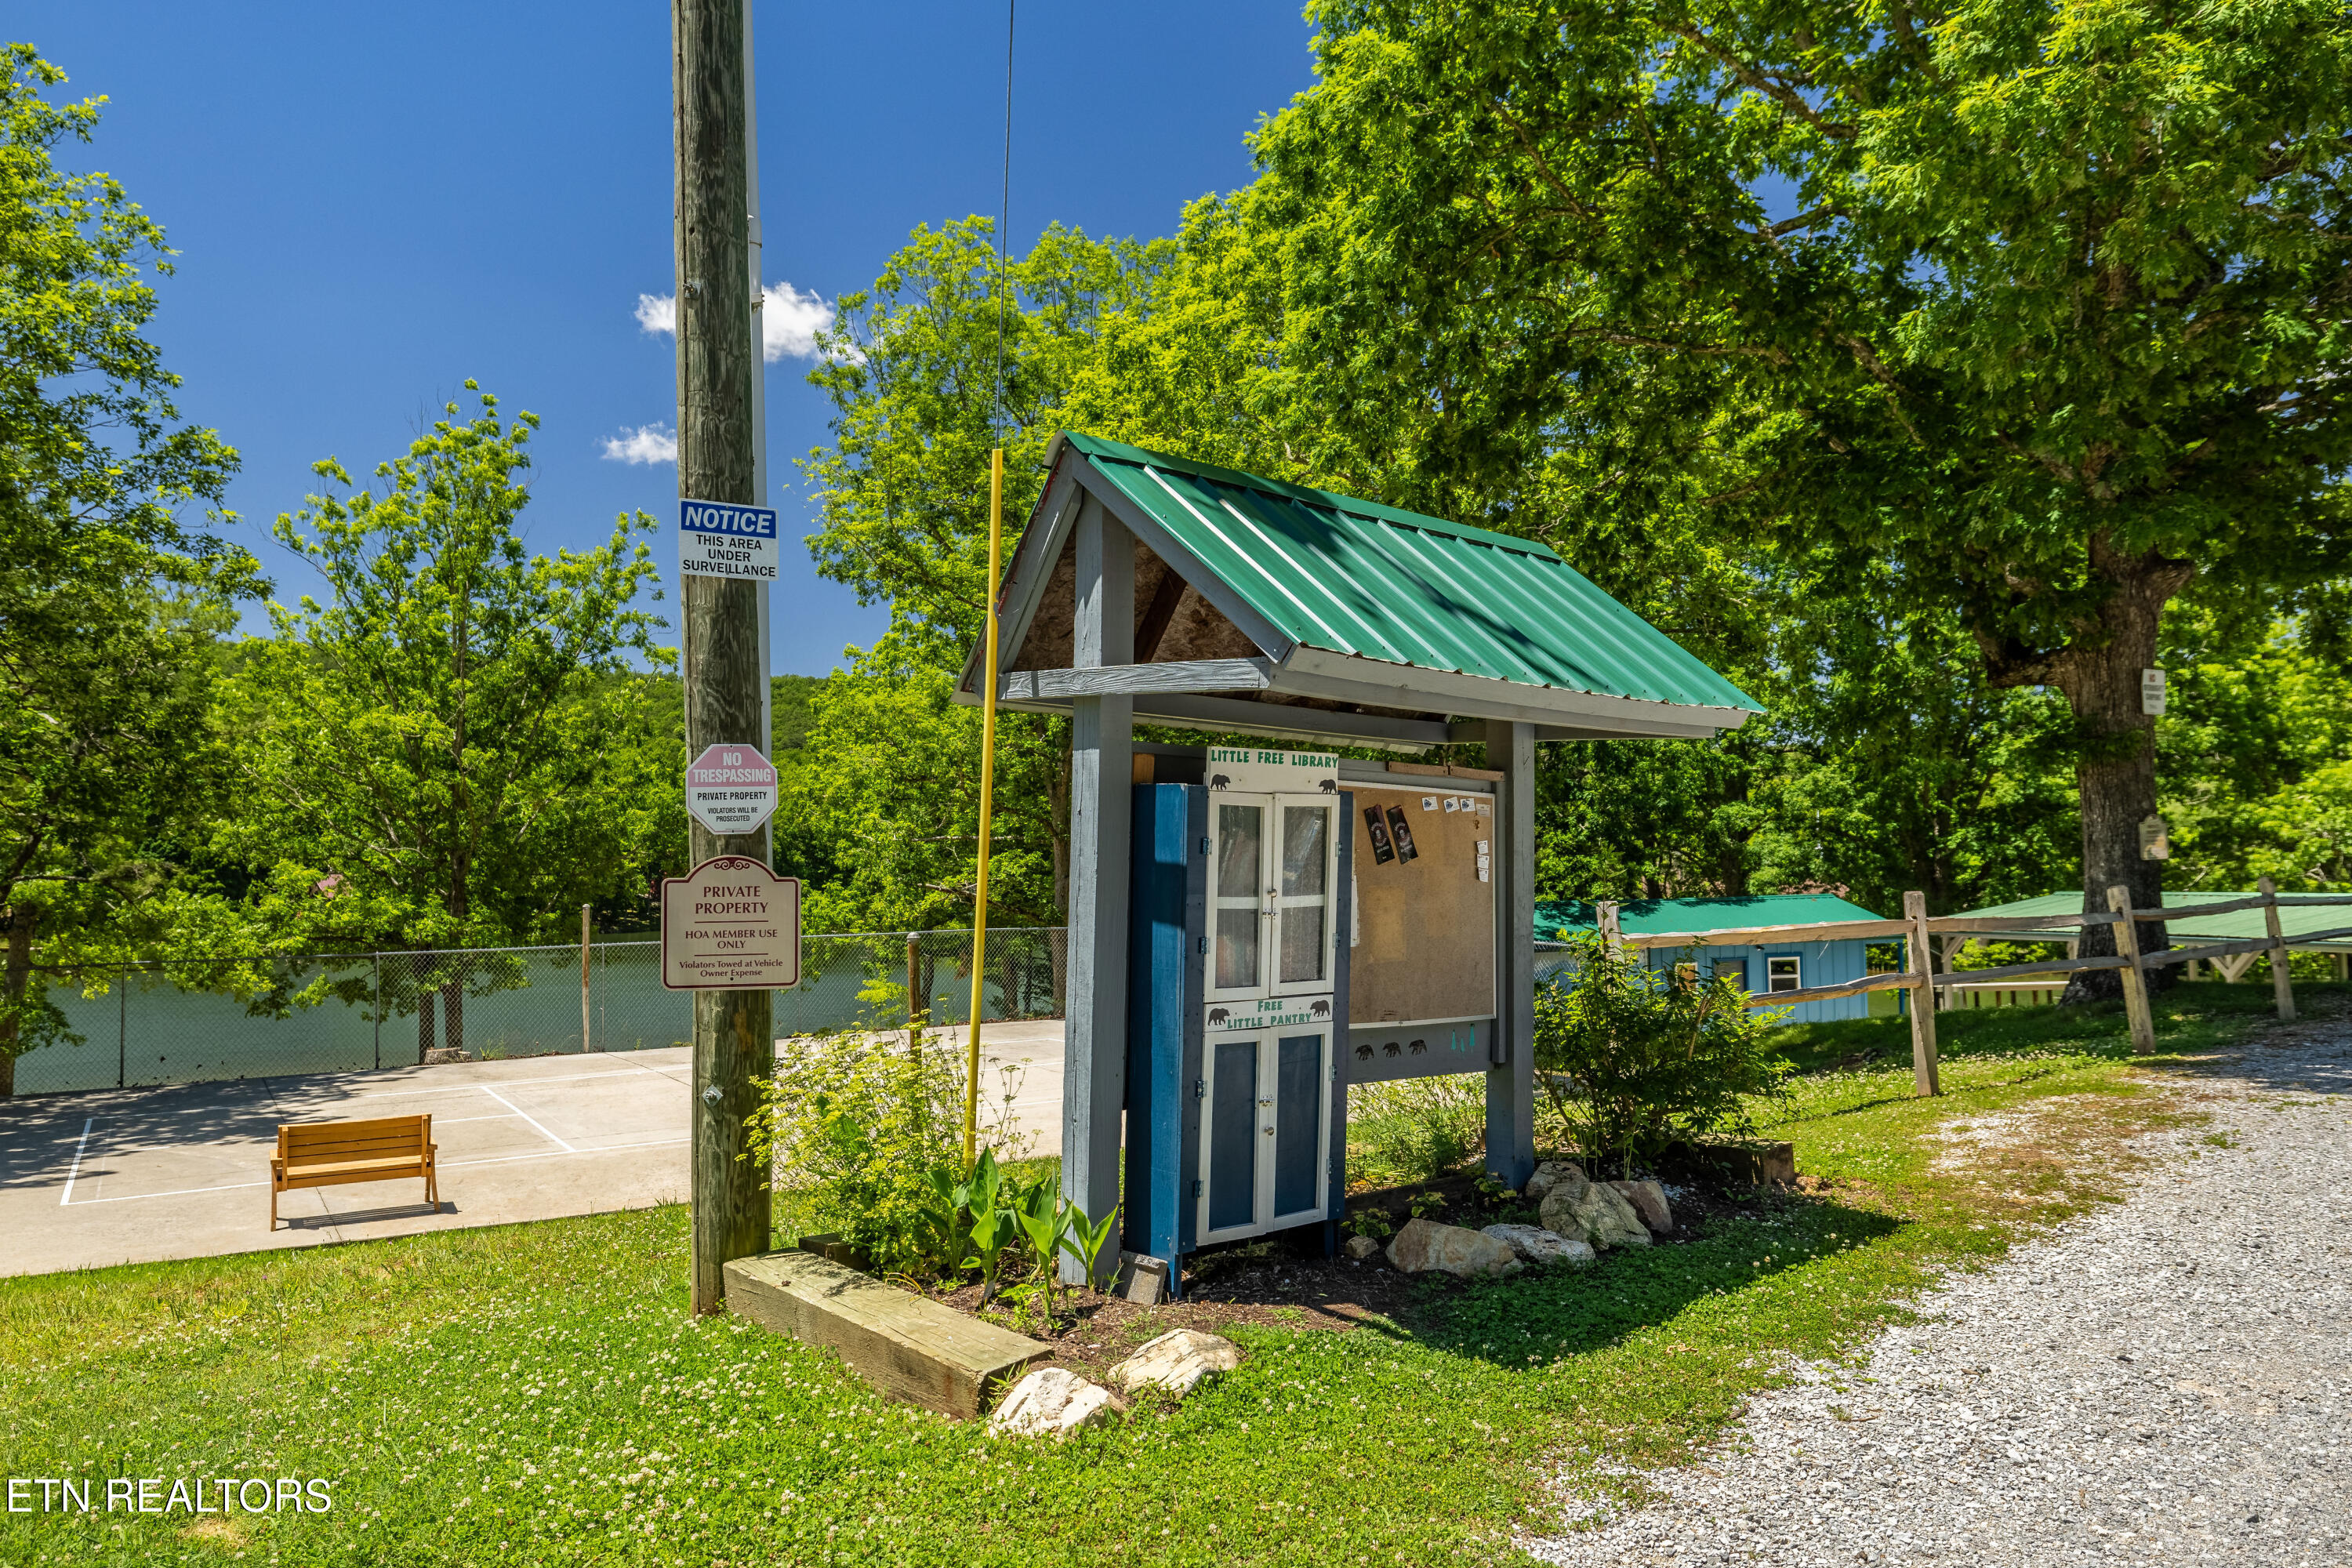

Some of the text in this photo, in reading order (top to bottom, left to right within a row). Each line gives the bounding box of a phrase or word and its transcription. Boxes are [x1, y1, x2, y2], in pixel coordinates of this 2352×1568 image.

[685, 506, 771, 533] NOTICE
[696, 535, 762, 550] THIS AREA
[708, 549, 750, 562] UNDER
[683, 560, 775, 576] SURVEILLANCE
[723, 753, 742, 766] NO
[1211, 750, 1338, 768] LITTLE FREE LIBRARY
[693, 769, 771, 782] TRESPASSING
[698, 792, 728, 800] PRIVATE
[703, 886, 760, 898] PRIVATE
[695, 902, 768, 914] PROPERTY
[685, 929, 778, 939] HOA MEMBER USE
[717, 941, 746, 949] ONLY
[680, 960, 715, 969] Violators
[718, 960, 742, 968] Towed
[754, 959, 783, 967] Vehicle
[731, 969, 762, 978] Expense
[1258, 1000, 1283, 1012] FREE
[1227, 1013, 1312, 1029] LITTLE PANTRY
